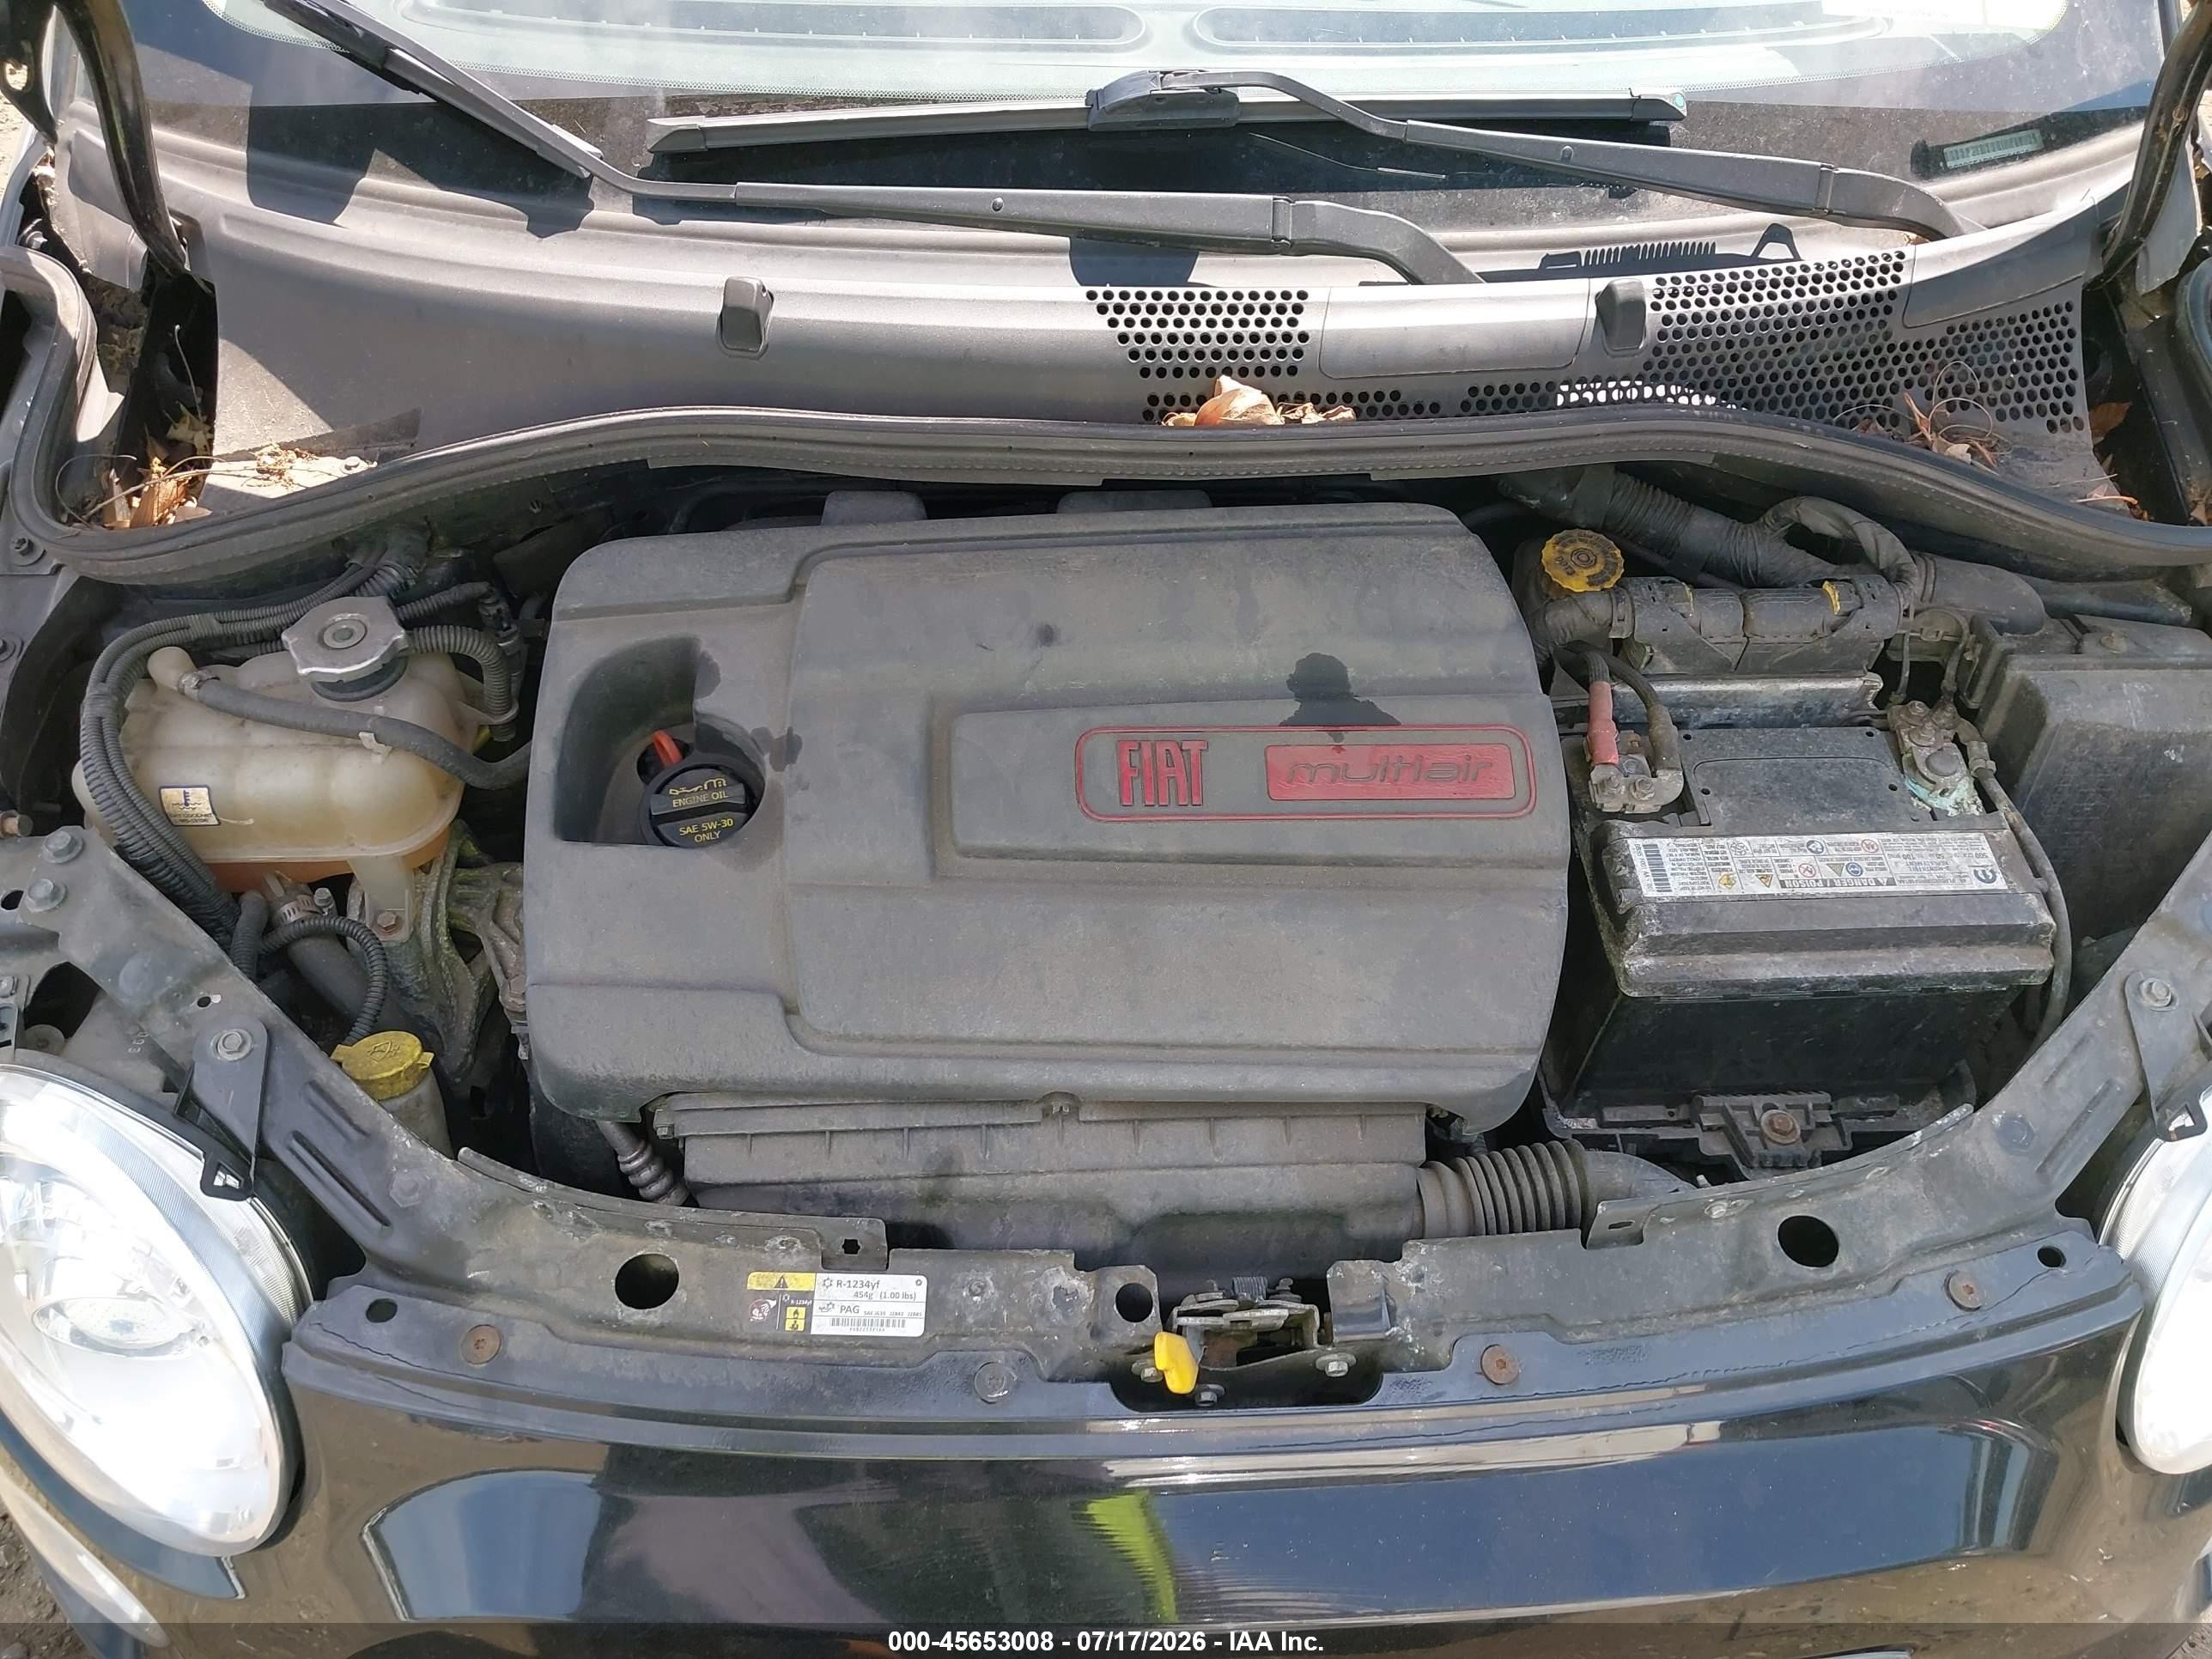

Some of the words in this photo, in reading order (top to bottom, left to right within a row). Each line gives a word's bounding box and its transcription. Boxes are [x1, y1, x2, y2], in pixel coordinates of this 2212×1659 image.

[1117, 740, 1208, 806] FIAT
[1287, 754, 1493, 785] multiair
[672, 793, 708, 807] ENGINE
[711, 790, 729, 800] OIL
[679, 825, 699, 836] SAE
[701, 817, 734, 830] 5W-30
[694, 830, 721, 842] ONLY
[1785, 878, 1823, 889] POISON
[1833, 878, 1875, 887] DANGER
[836, 1279, 880, 1290] R-1234yf
[854, 1291, 873, 1300] 454g
[879, 1291, 900, 1300] (1.00
[901, 1291, 916, 1301] lbs)
[839, 1305, 860, 1314] PAG
